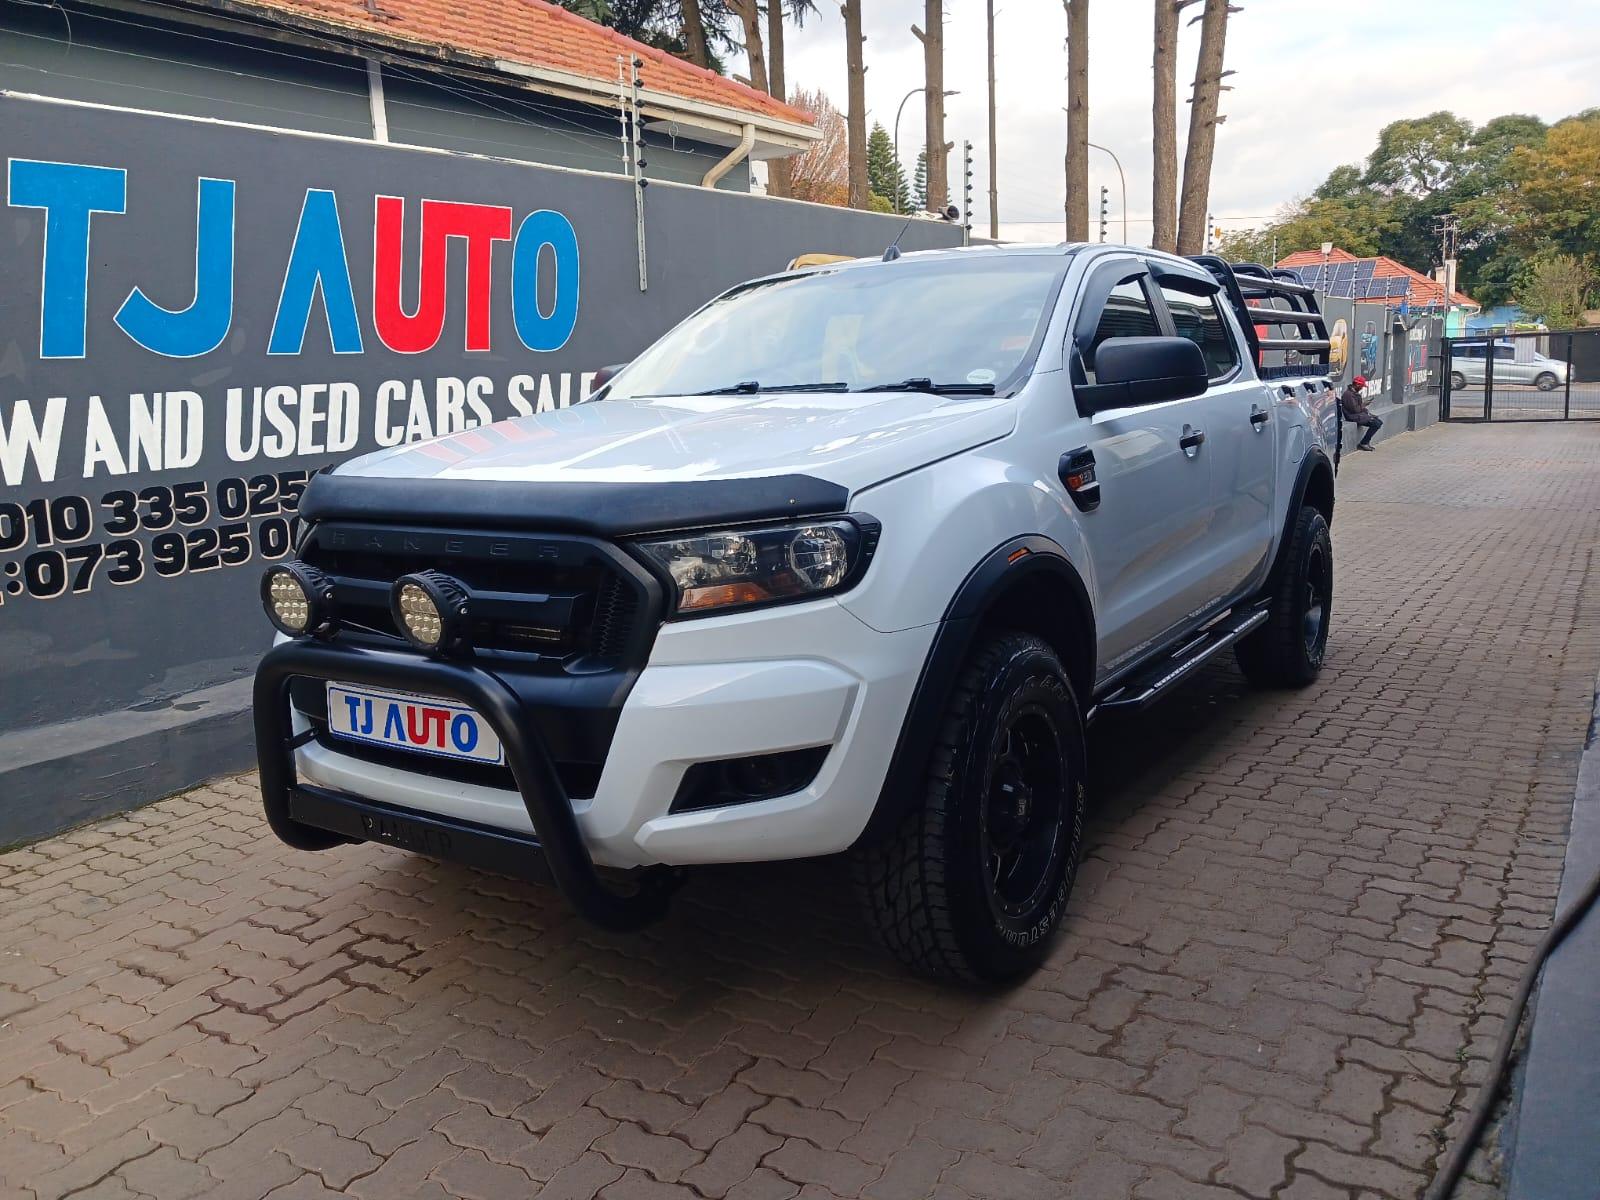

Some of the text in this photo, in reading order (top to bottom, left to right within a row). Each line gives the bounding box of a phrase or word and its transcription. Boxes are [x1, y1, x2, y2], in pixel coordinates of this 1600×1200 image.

[8, 158, 580, 359] TJ AUTO
[83, 391, 205, 479] AND
[225, 382, 362, 463] USED
[374, 375, 495, 448] CARS
[101, 481, 210, 536] 335
[216, 470, 316, 520] 025
[0, 538, 145, 605] :073
[151, 522, 252, 577] 925
[344, 696, 479, 753] TJ AUTO
